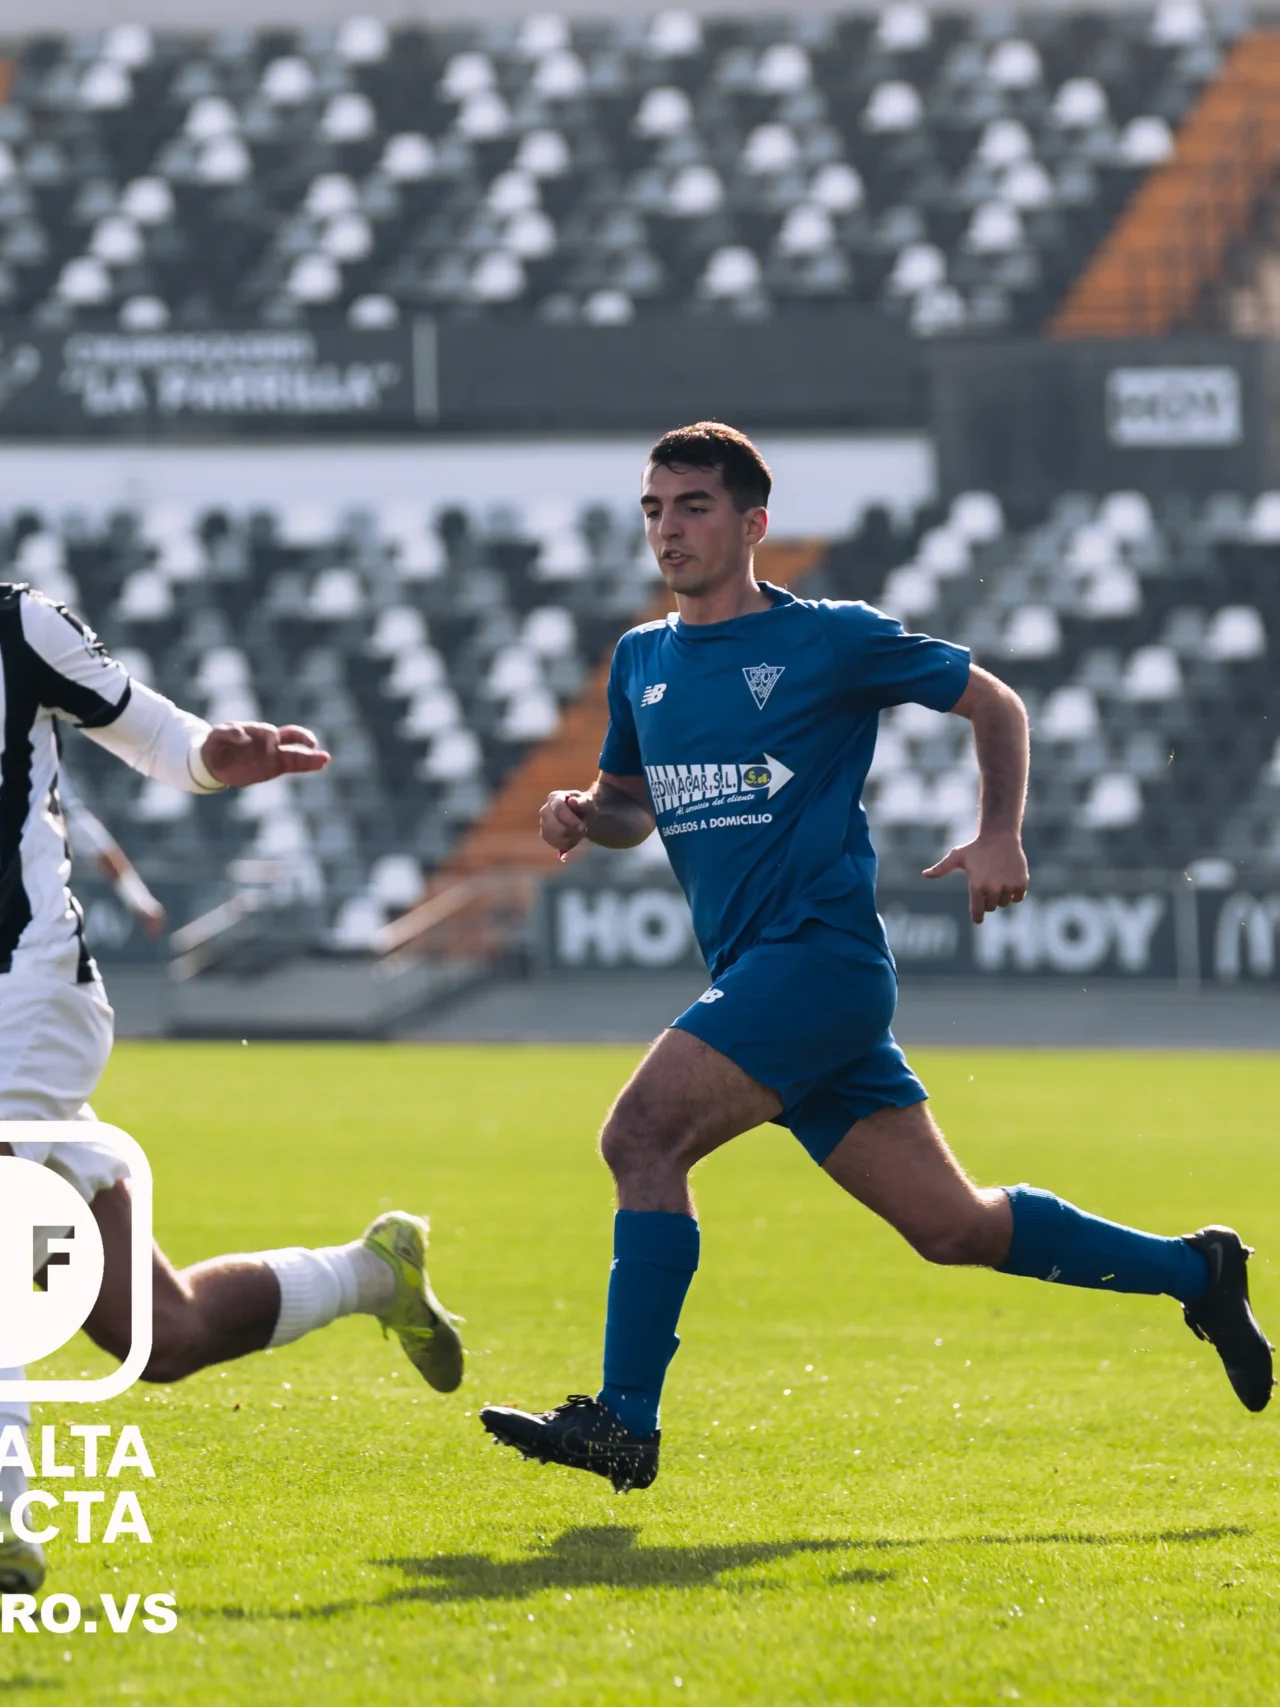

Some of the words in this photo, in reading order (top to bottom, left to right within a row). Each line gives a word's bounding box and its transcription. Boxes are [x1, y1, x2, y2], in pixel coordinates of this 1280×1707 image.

[1115, 385, 1225, 428] HOY
[712, 797, 725, 806] del
[727, 793, 756, 803] cliente
[700, 820, 708, 830] A
[709, 813, 773, 828] DOMICILIO
[558, 888, 698, 968] HO
[974, 894, 1163, 972] HOY
